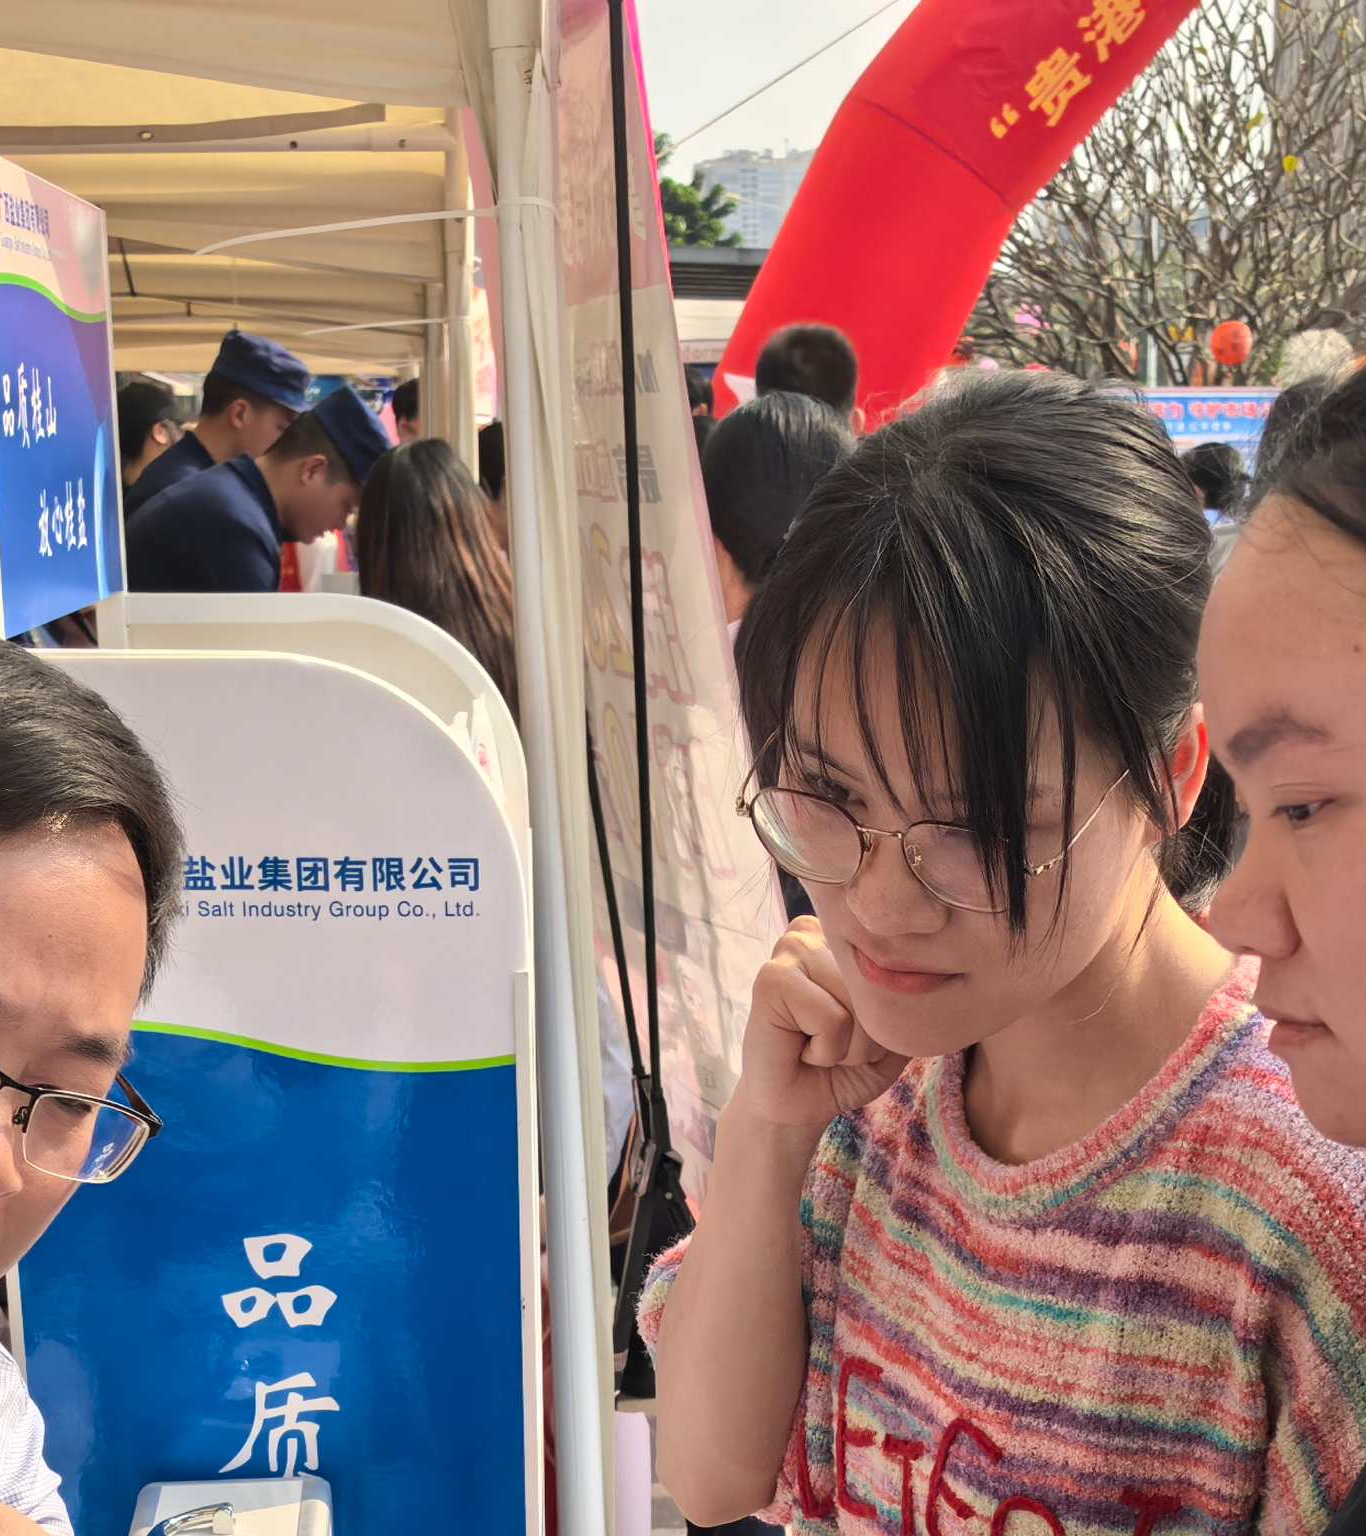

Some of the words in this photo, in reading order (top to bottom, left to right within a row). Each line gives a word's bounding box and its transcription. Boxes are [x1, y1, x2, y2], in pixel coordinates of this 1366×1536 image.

[183, 855, 481, 892] 盐业集团有限公司
[197, 900, 235, 918] Salt
[242, 900, 321, 921] Industry
[329, 900, 390, 921] Group
[397, 901, 436, 920] Co.,
[444, 901, 481, 918] Ltd.
[219, 1233, 341, 1479] 品质
